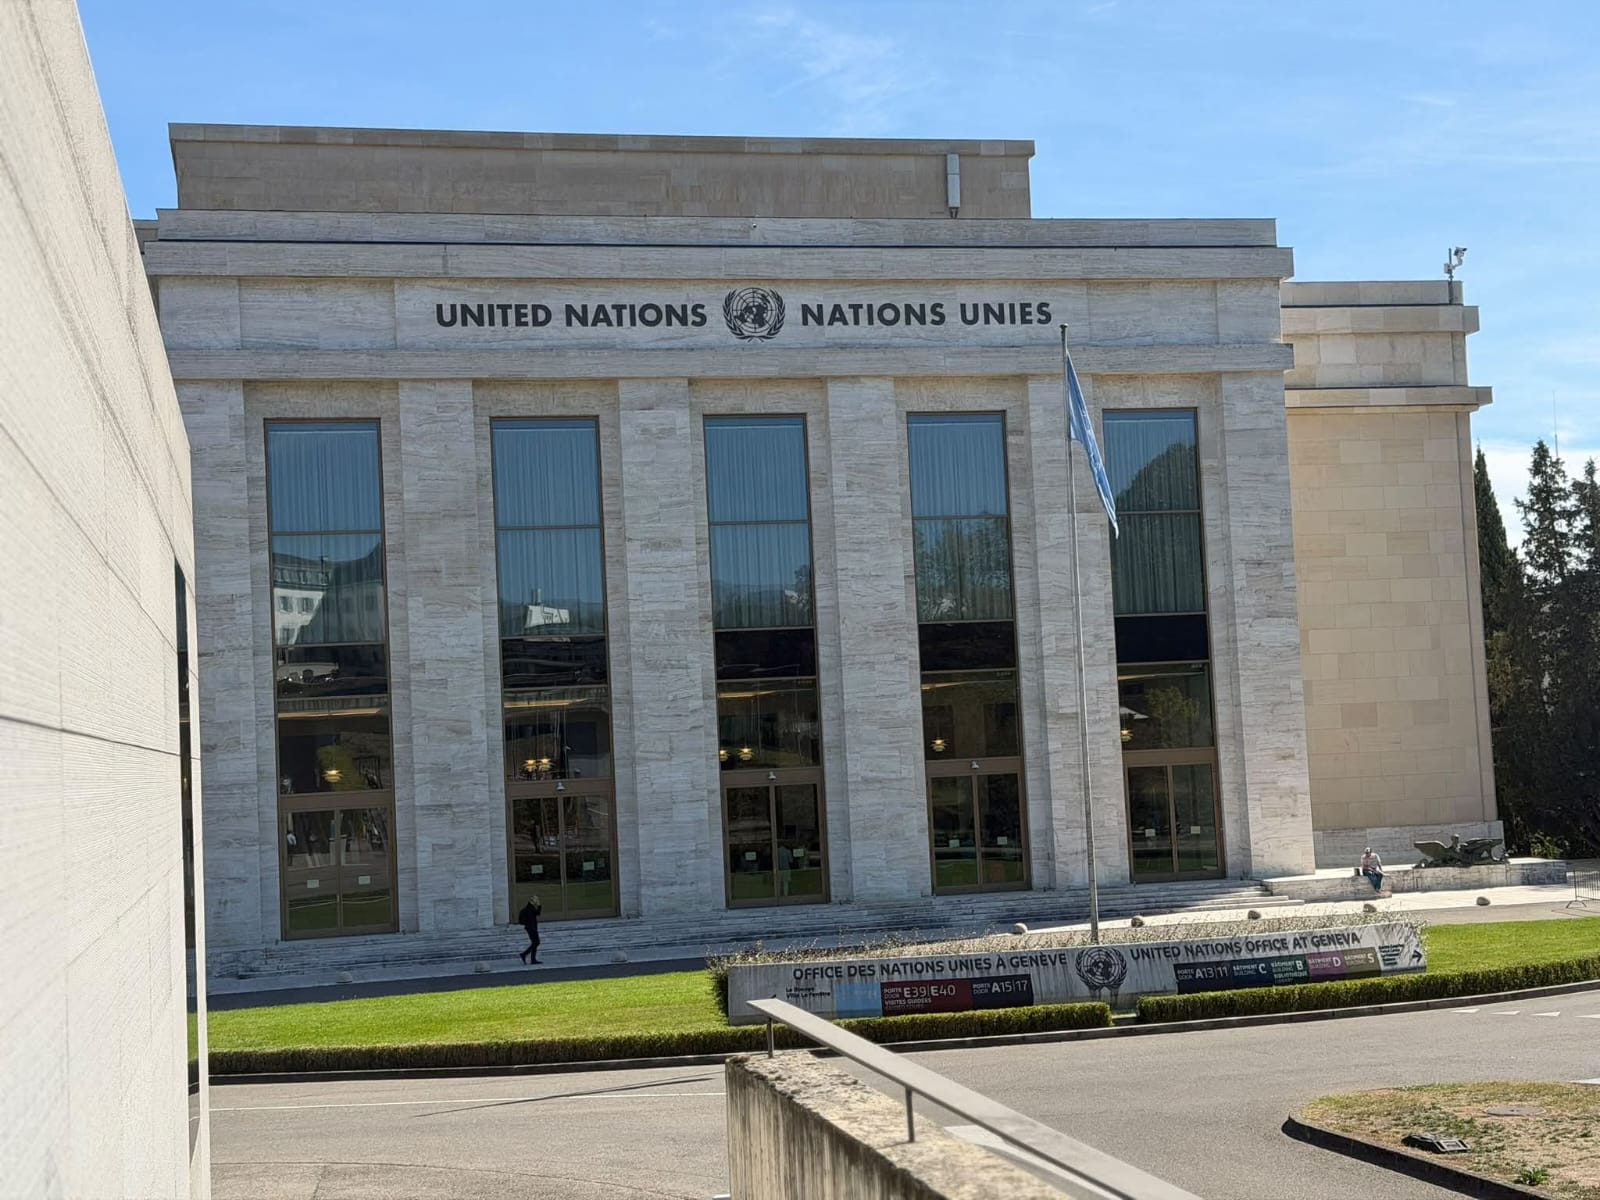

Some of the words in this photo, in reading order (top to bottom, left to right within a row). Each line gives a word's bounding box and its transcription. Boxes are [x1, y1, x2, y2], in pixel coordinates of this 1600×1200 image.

[436, 304, 553, 328] UNITED
[564, 303, 708, 328] NATIONS
[800, 302, 947, 327] NATIONS
[959, 301, 1053, 325] UNIES
[1130, 946, 1181, 961] UNITED
[1185, 942, 1242, 957] NATIONS
[1245, 937, 1289, 952] OFFICE
[1293, 936, 1309, 949] AT
[1311, 932, 1361, 948] GENEVA
[793, 966, 842, 980] OFFICE
[847, 965, 876, 977] DES
[880, 960, 945, 976] NATIONS
[949, 957, 992, 972] UNIES
[1010, 951, 1067, 969] GENÈVE
[1295, 960, 1304, 970] B
[1332, 957, 1341, 967] D
[1367, 953, 1375, 963] S
[1258, 963, 1268, 974] C
